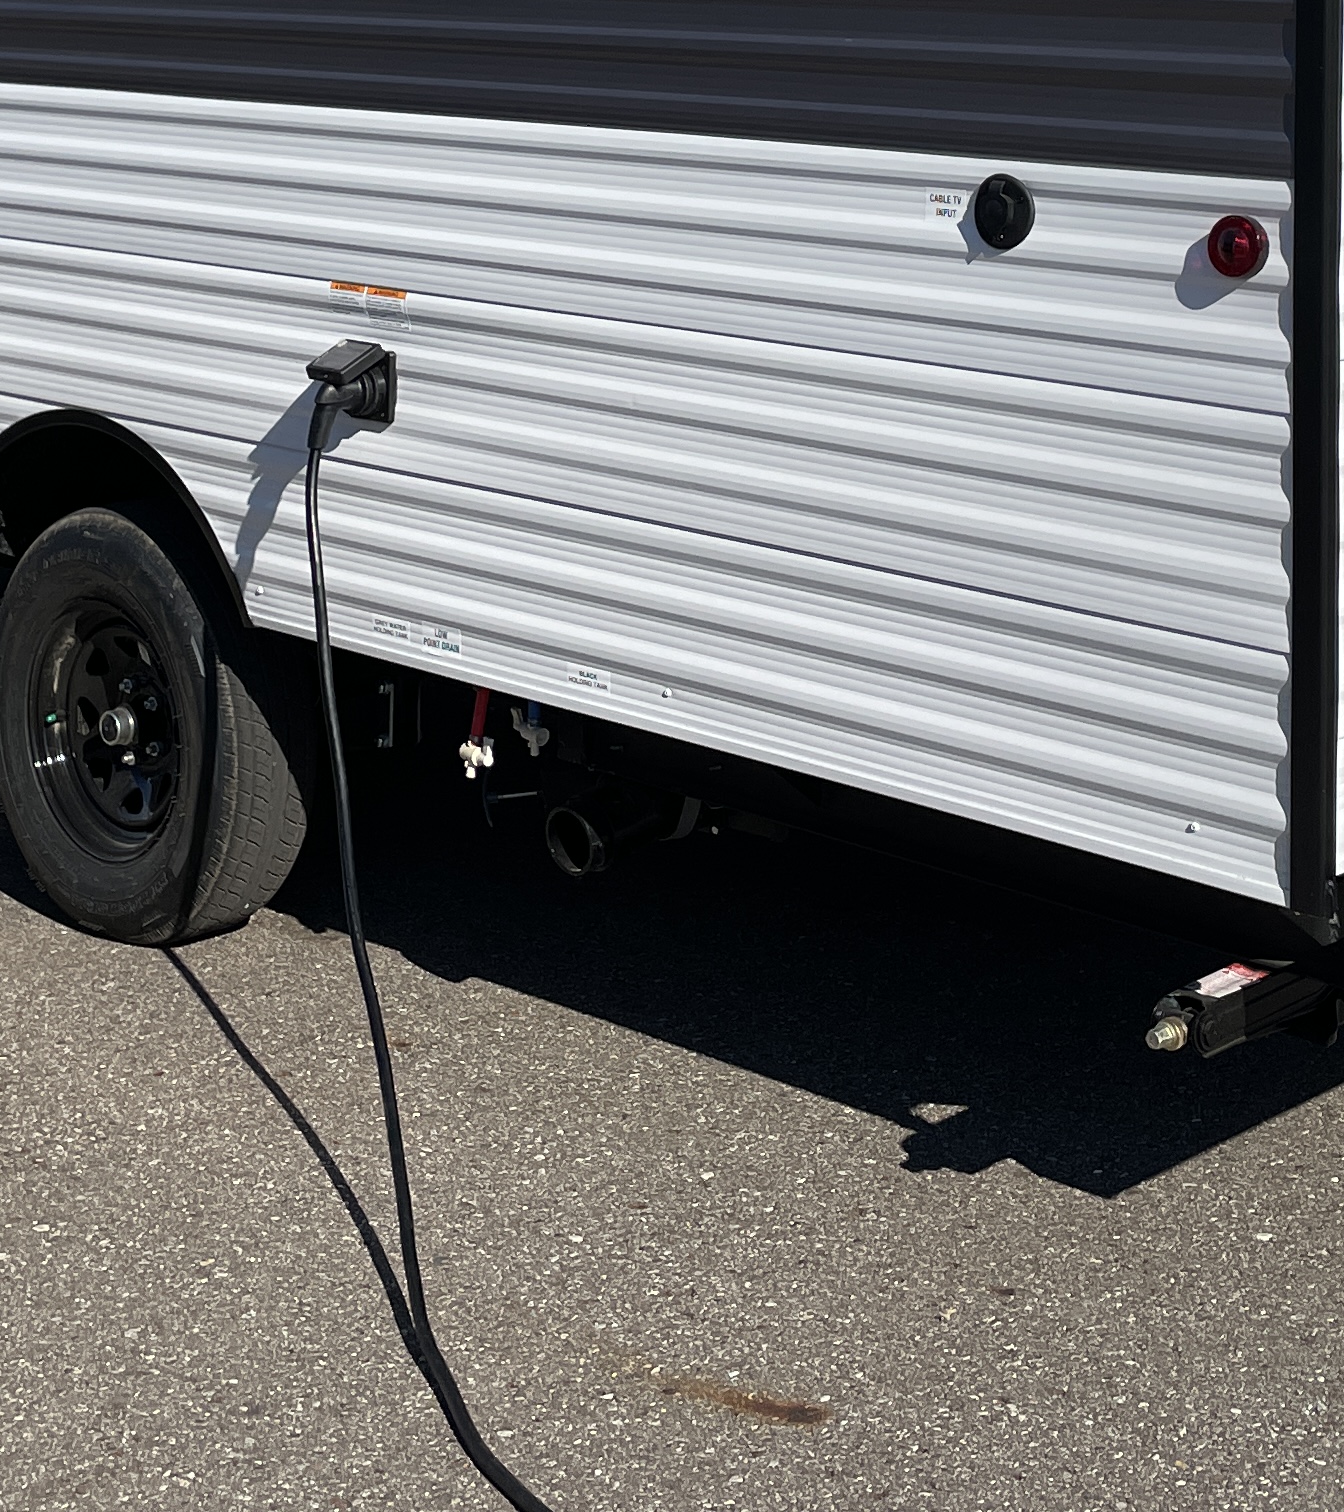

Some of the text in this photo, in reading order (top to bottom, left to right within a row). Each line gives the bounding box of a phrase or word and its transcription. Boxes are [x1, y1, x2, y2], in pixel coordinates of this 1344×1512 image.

[929, 193, 962, 205] CABLE TV
[434, 628, 449, 640] LOW
[423, 637, 441, 649] POINT
